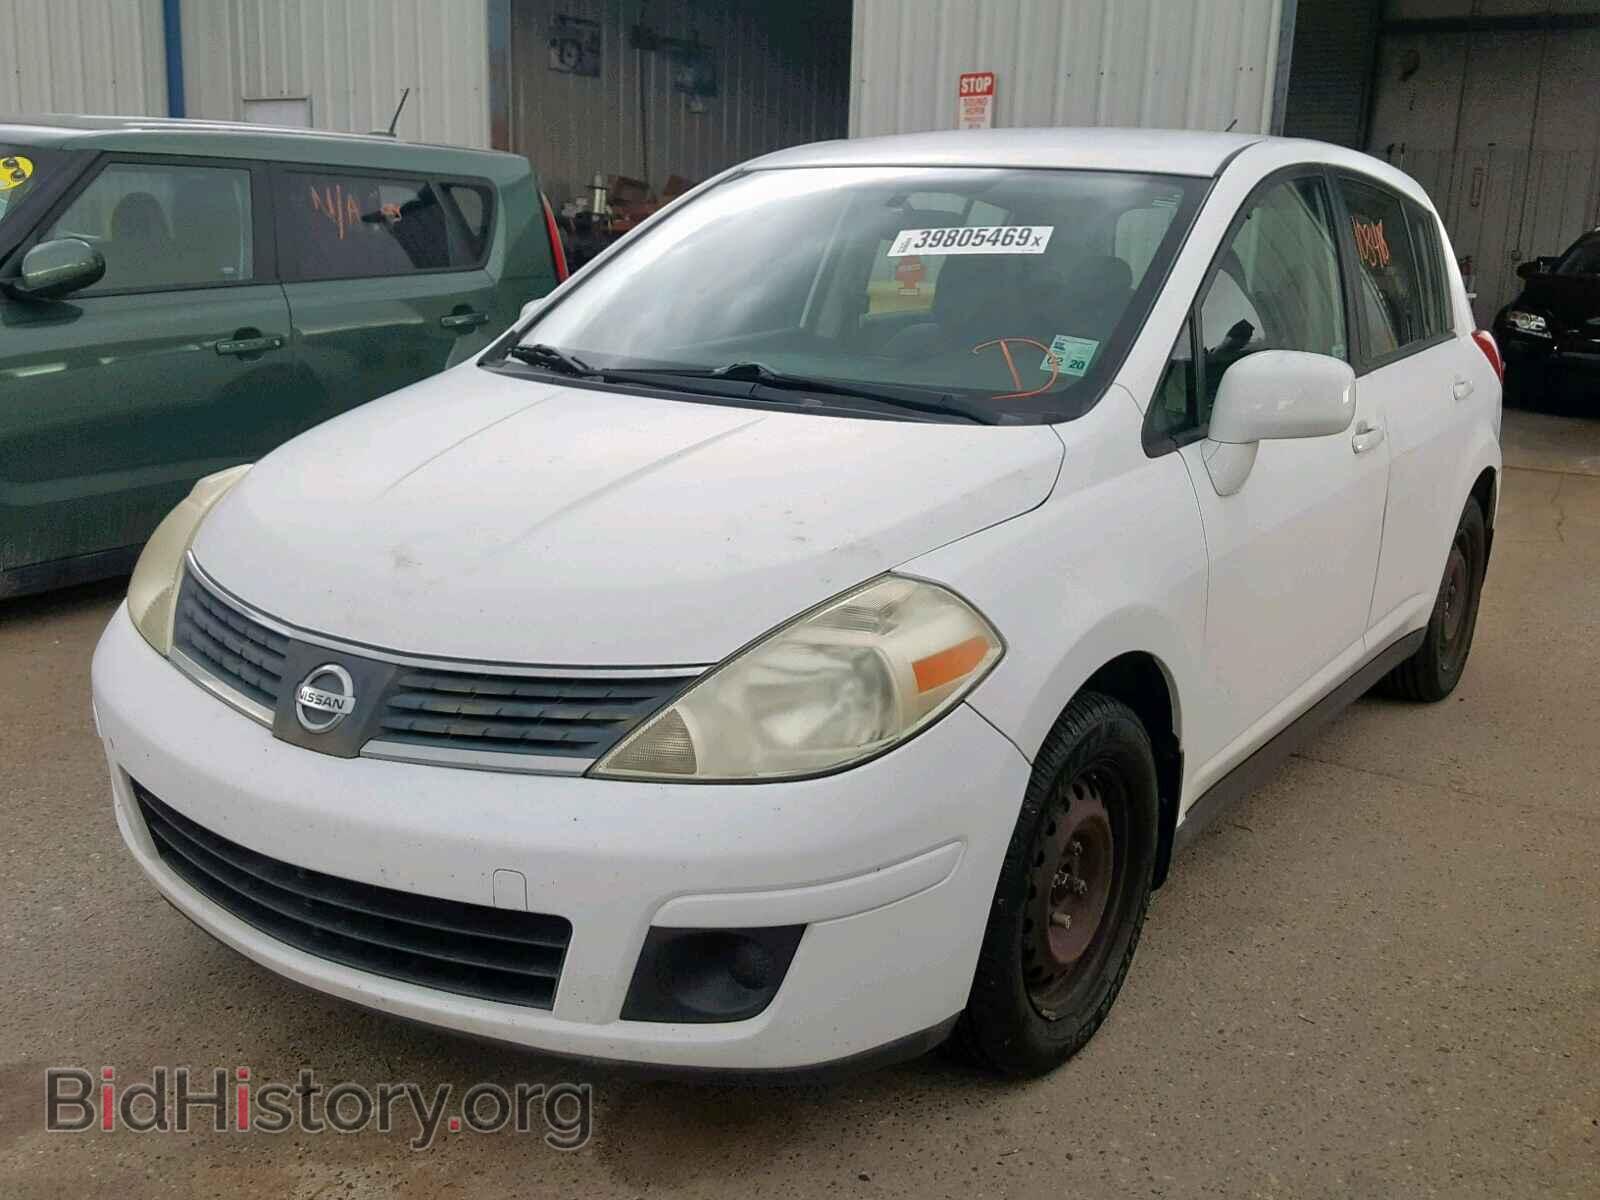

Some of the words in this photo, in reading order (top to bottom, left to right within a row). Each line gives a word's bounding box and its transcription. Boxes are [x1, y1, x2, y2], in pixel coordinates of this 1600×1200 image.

[960, 76, 992, 94] STOP
[1068, 359, 1086, 370] 20
[298, 688, 345, 710] NISSAN
